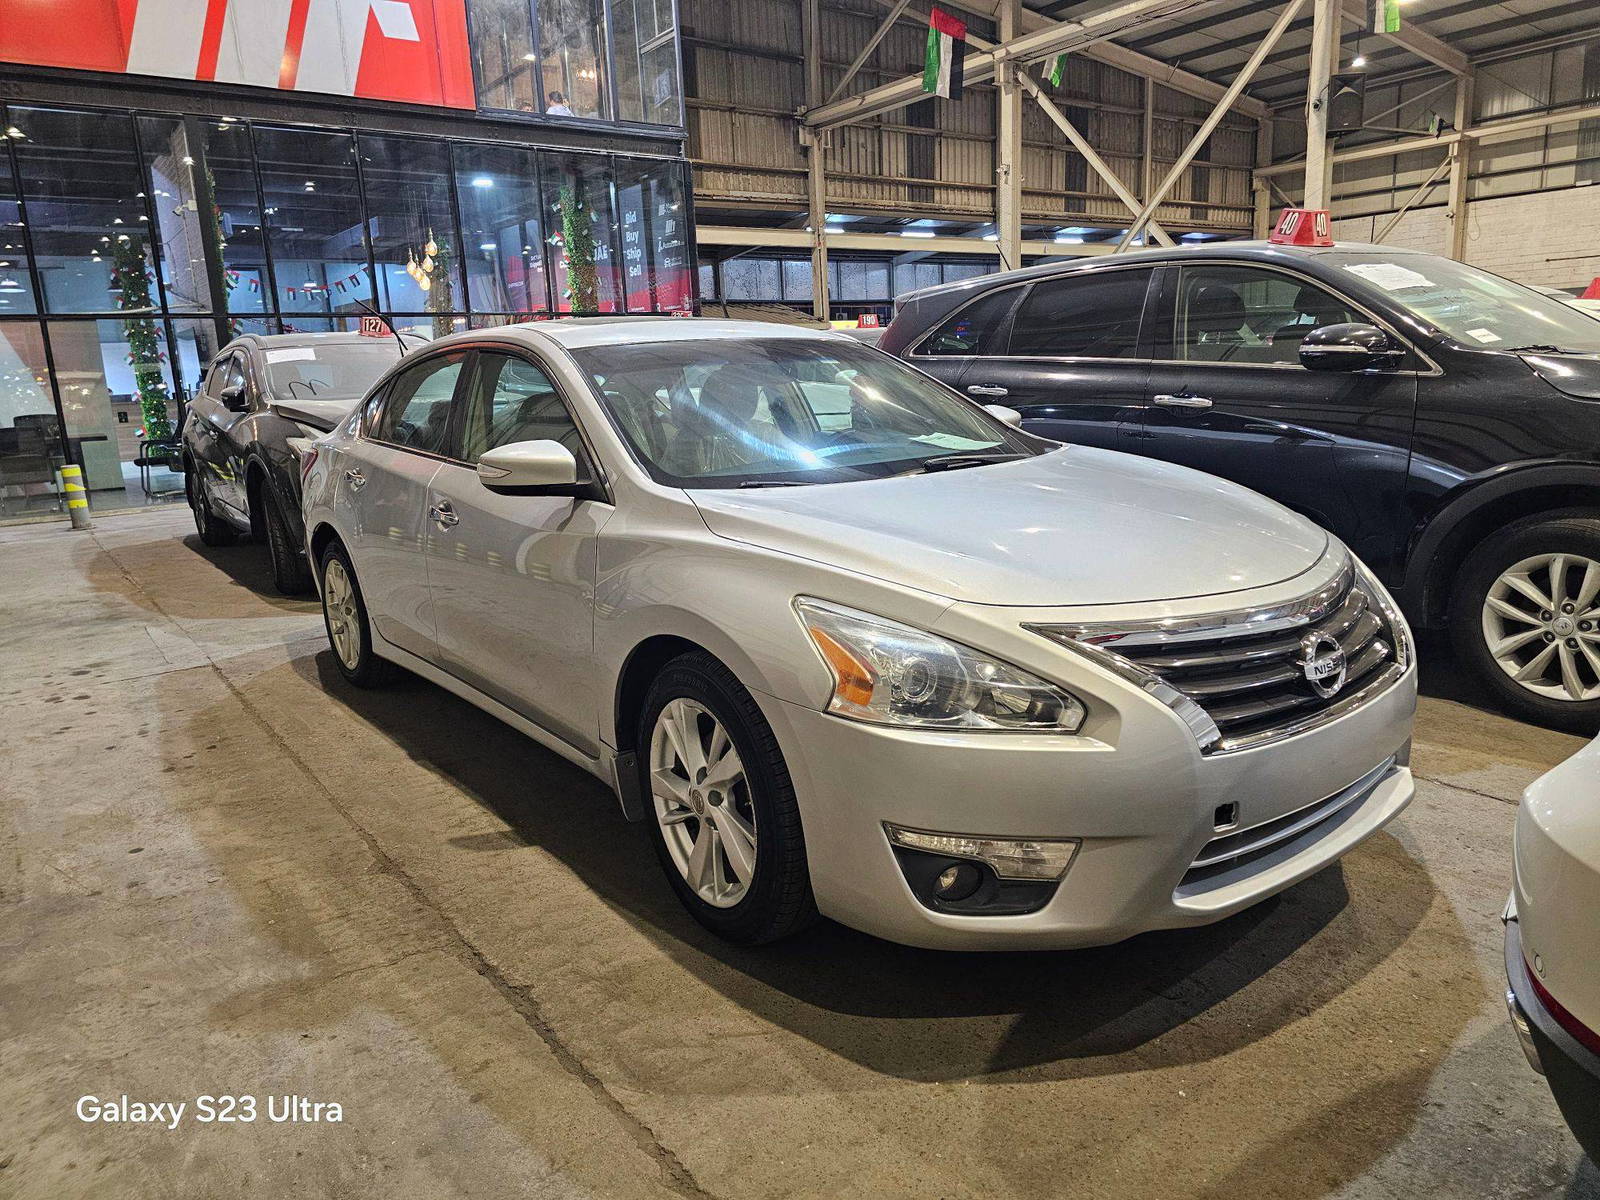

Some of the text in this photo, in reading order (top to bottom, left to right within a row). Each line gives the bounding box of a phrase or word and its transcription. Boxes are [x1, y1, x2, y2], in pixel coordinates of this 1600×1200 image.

[625, 211, 637, 224] Bid
[1281, 212, 1299, 235] 40
[1316, 213, 1327, 237] 40
[625, 231, 639, 244] Buy
[629, 264, 642, 277] Sell
[364, 318, 382, 332] 127
[862, 315, 876, 325] 190
